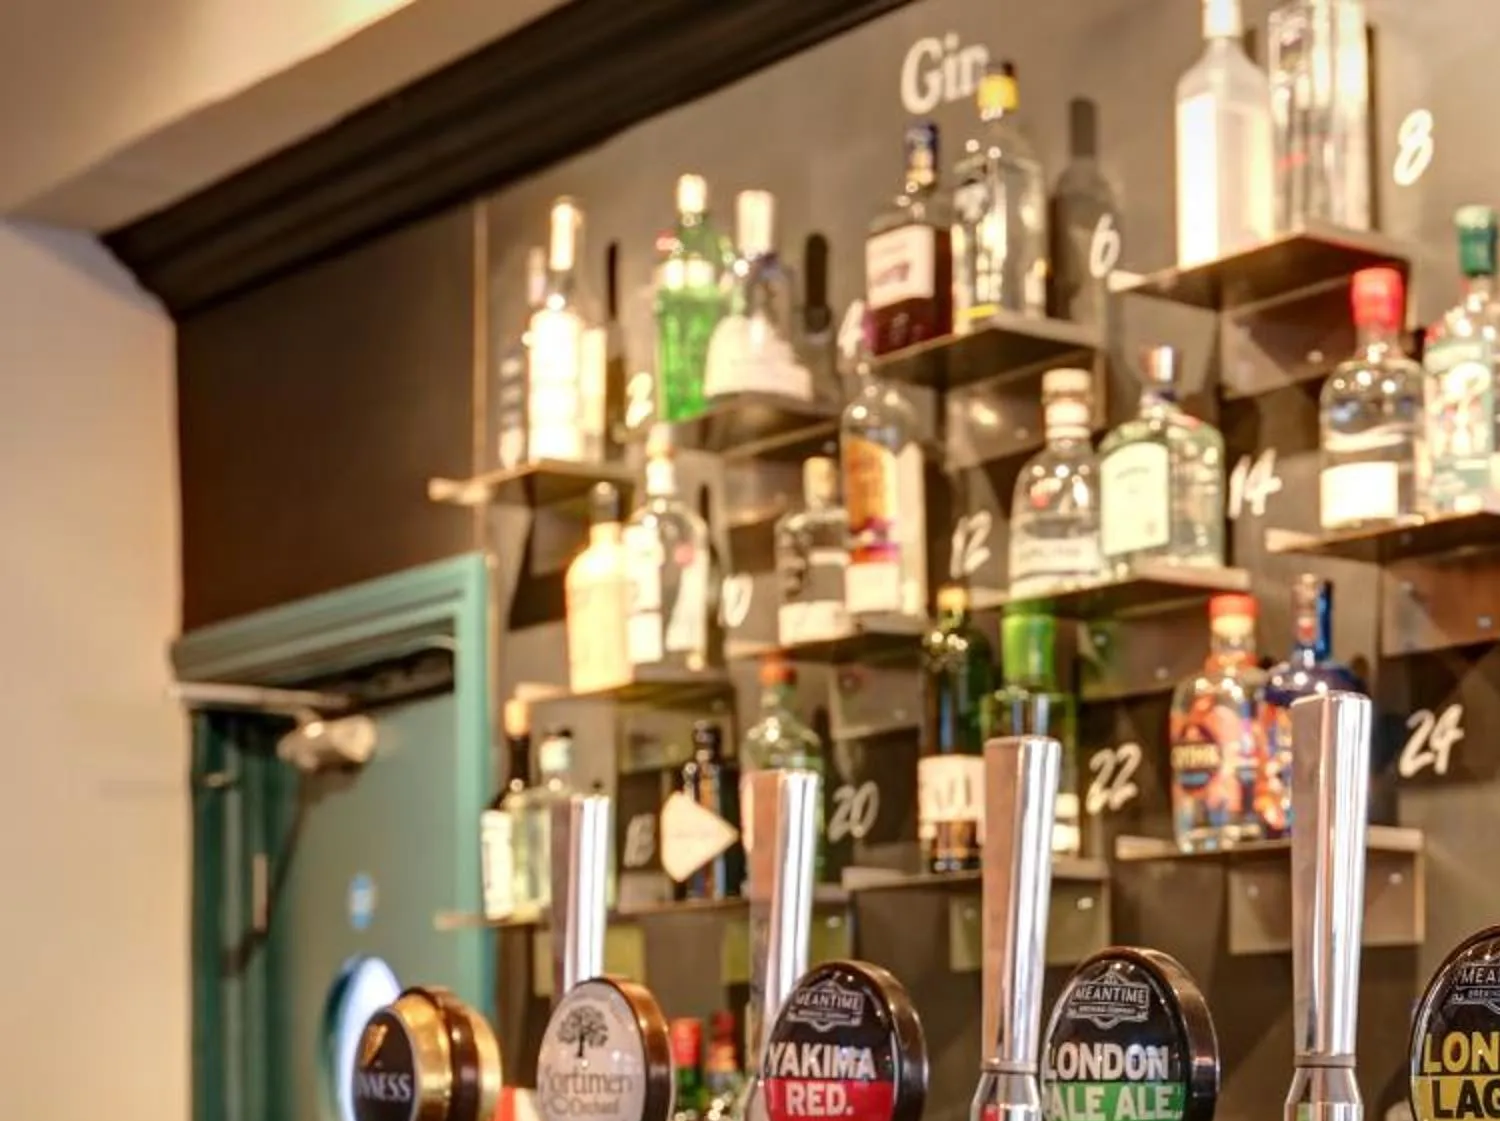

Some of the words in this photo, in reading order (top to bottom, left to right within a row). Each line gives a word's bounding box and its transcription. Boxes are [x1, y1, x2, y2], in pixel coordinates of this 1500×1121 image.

[1394, 108, 1434, 186] 8
[1090, 213, 1121, 277] 6
[949, 510, 992, 578] 12
[1399, 704, 1465, 778] 24
[1087, 742, 1142, 814] 22
[829, 781, 879, 841] 20
[1074, 985, 1147, 1004] MEANTIME
[769, 1042, 877, 1080] YAKIMA
[1043, 1042, 1169, 1080] LONDON
[785, 1081, 854, 1117] RED.
